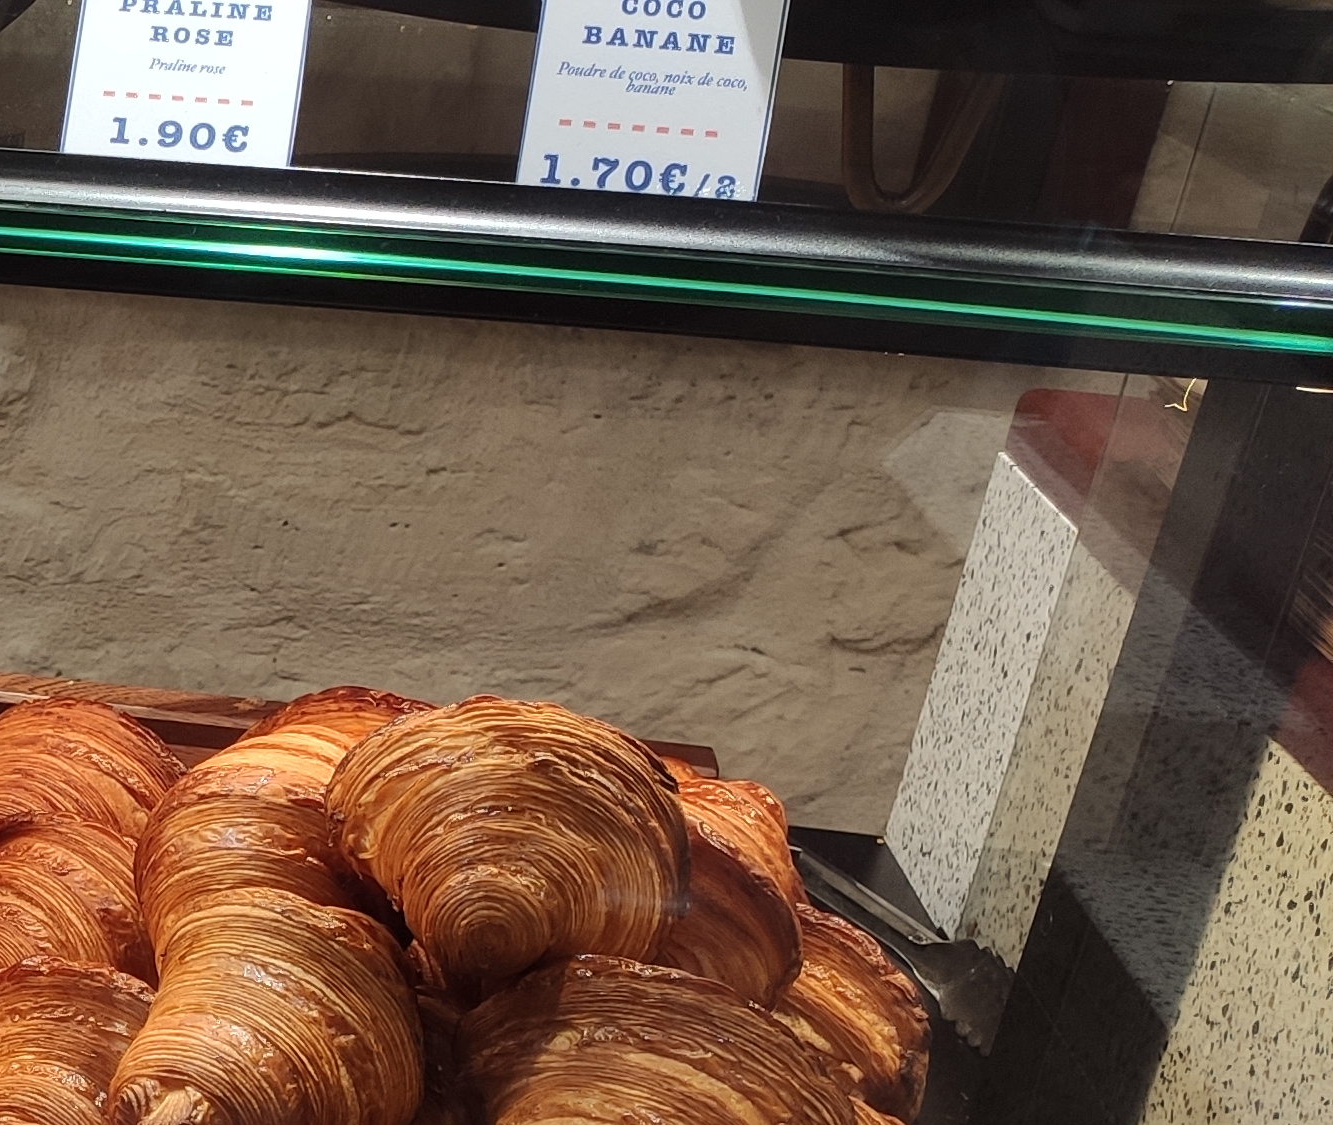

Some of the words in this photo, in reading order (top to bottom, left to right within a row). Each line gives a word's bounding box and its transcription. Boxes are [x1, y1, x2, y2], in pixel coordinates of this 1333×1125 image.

[119, 0, 272, 21] PRALINE
[622, 0, 706, 19] COCO
[149, 26, 233, 46] ROSE
[582, 25, 735, 55] BANANE
[149, 58, 197, 73] Praline
[199, 63, 225, 75] rose
[557, 61, 606, 77] Poudre
[609, 65, 625, 79] de
[628, 71, 659, 84] coco,
[663, 71, 694, 85] noix
[698, 72, 713, 86] de
[717, 79, 748, 91] coco,
[625, 82, 676, 95] banane
[110, 117, 249, 152] 1.90€
